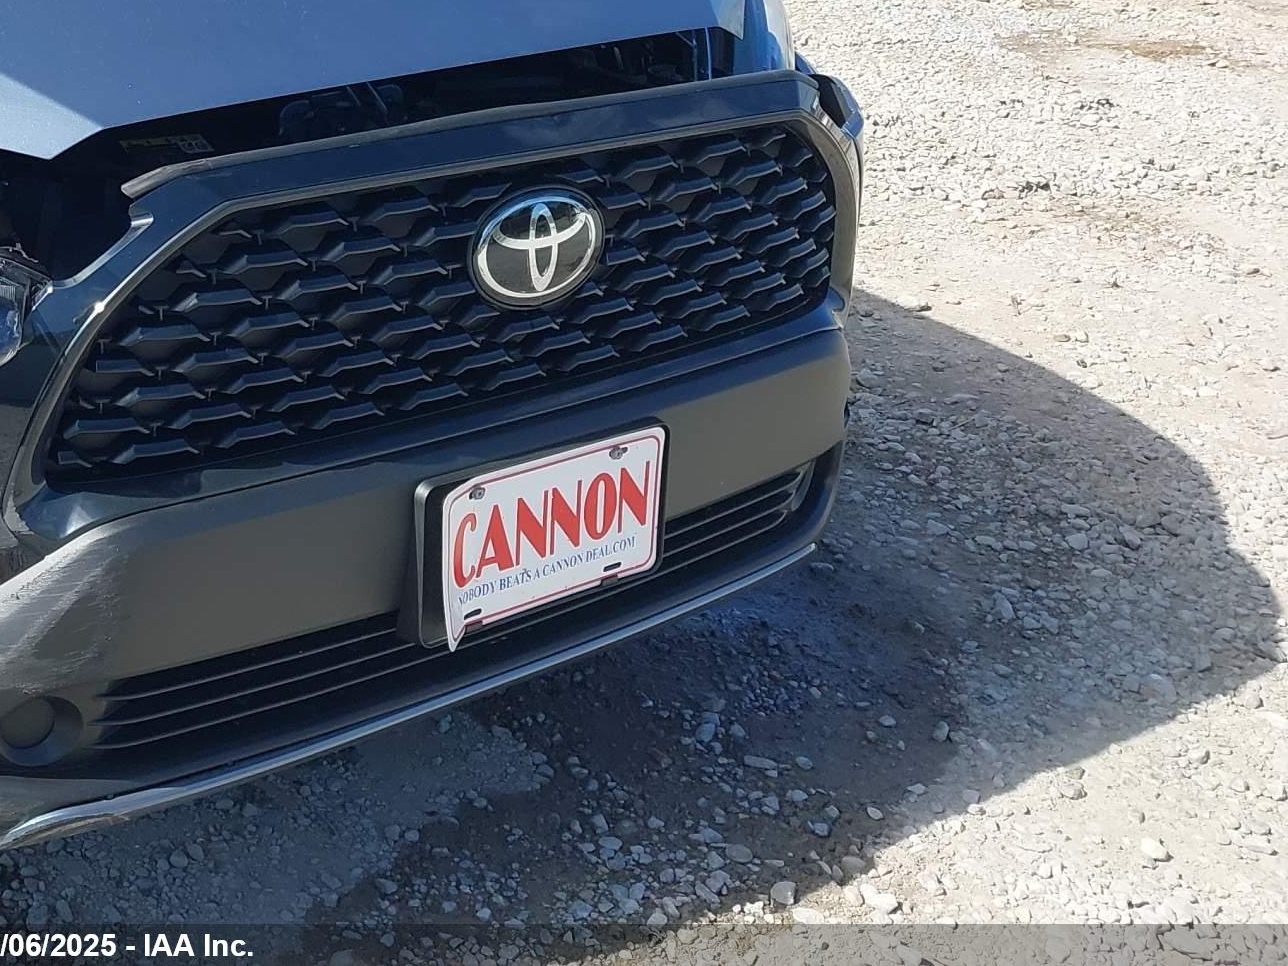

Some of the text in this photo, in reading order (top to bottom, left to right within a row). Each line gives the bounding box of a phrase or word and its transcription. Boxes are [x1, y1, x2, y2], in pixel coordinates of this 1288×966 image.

[453, 460, 651, 588] CANNON
[458, 536, 636, 606] NOBODY BEATS A CANNON DEAL.COM
